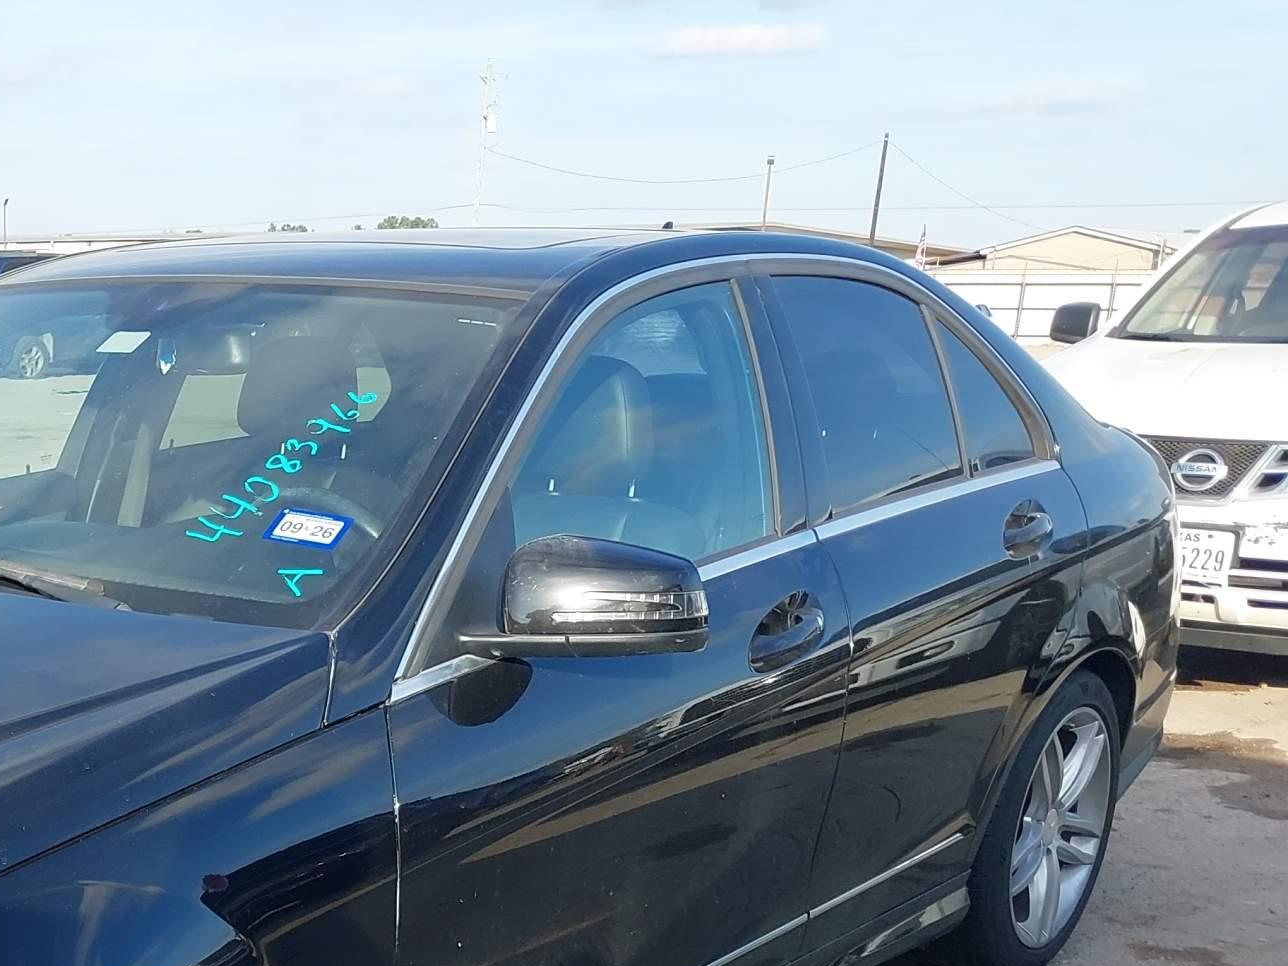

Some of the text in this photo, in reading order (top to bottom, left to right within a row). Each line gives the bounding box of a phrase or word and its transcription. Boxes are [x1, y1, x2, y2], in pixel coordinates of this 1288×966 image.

[1175, 463, 1218, 473] NISSAN
[279, 520, 304, 534] 09
[309, 524, 335, 539] 26
[278, 568, 324, 597] A
